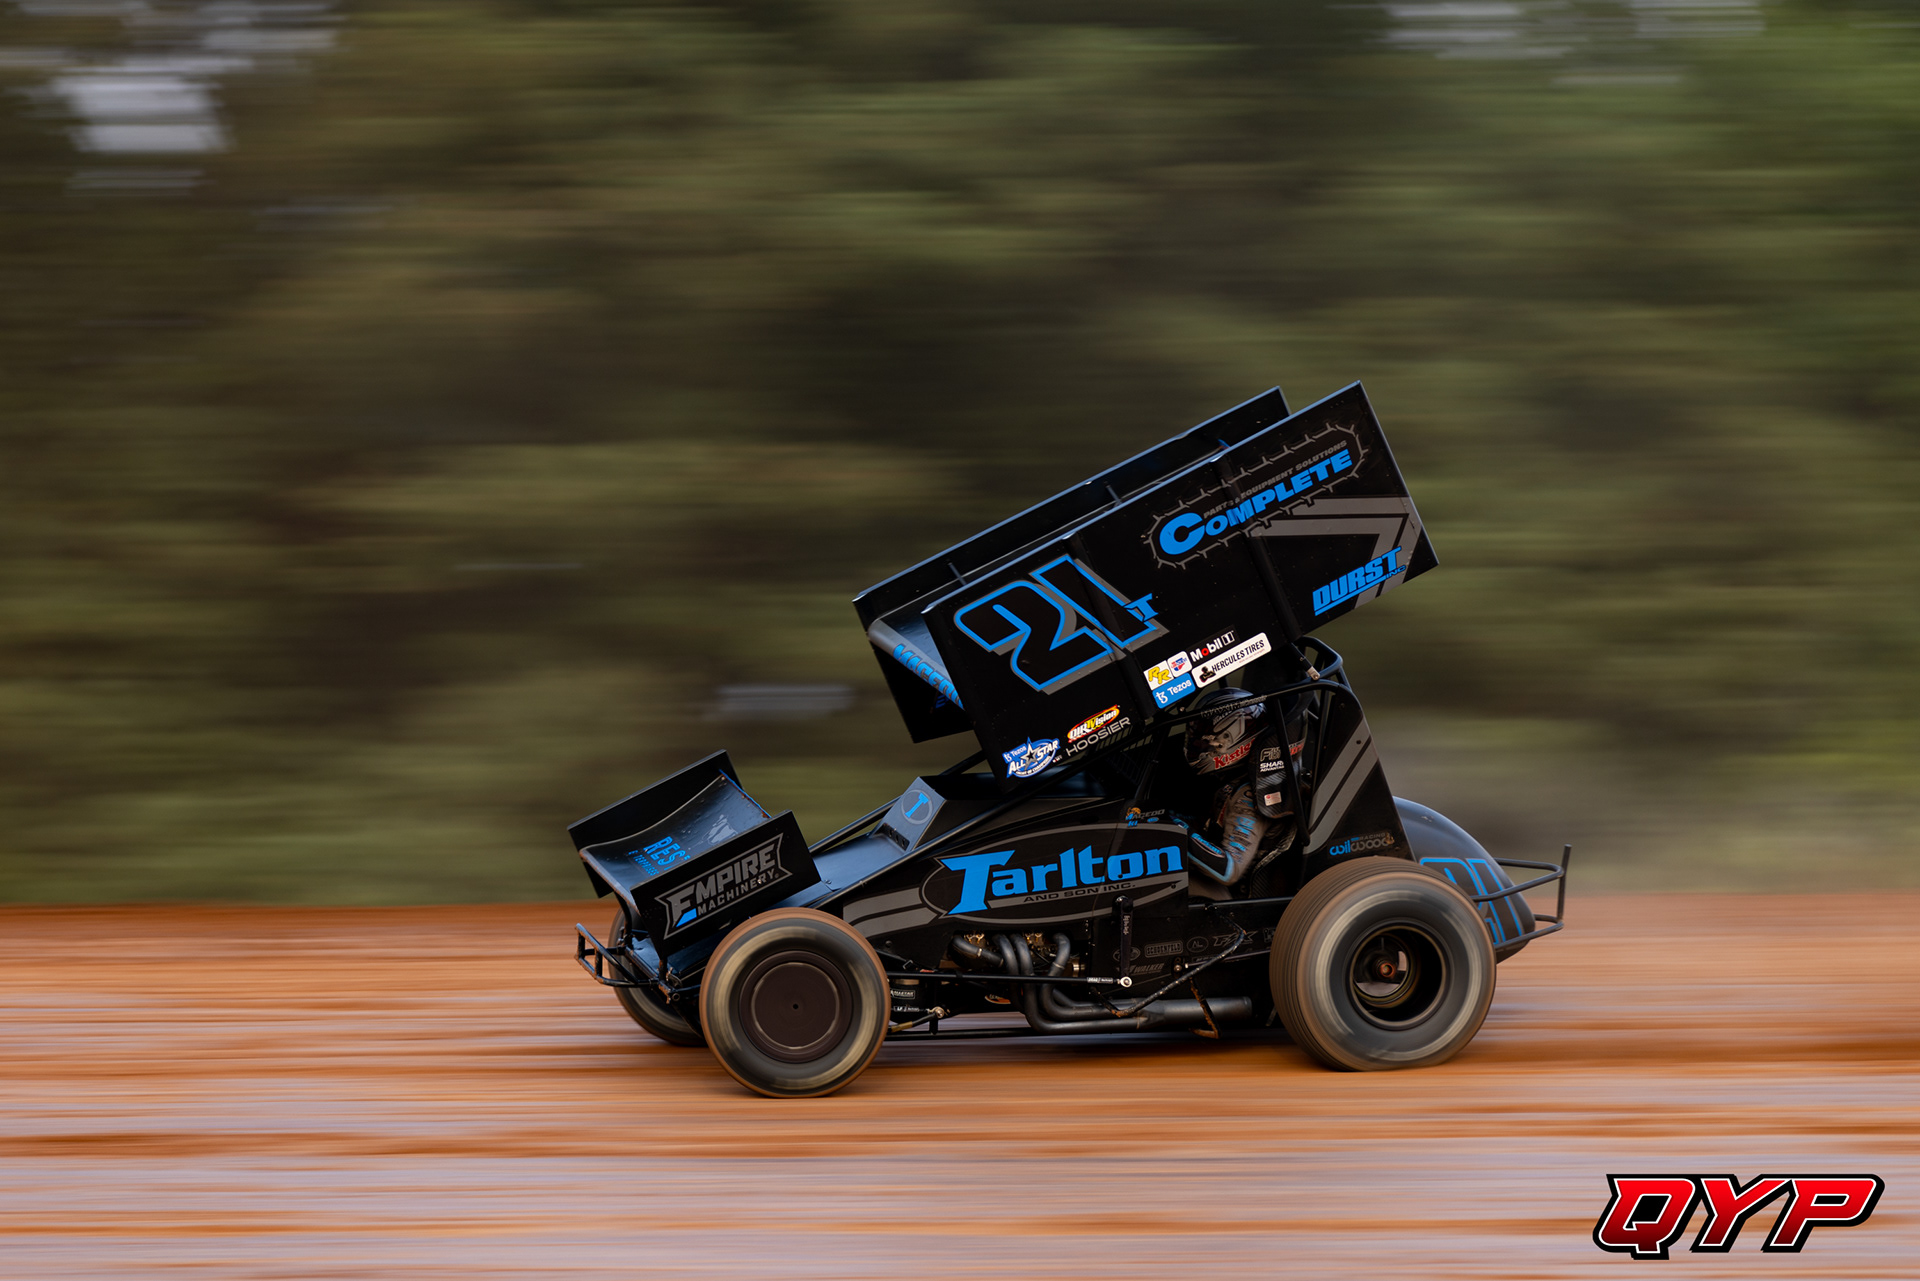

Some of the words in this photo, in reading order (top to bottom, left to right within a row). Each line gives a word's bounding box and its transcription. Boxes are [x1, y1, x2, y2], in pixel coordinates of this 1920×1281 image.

[1203, 501, 1234, 519] PARTS
[1240, 467, 1295, 499] EQUIPMENT
[1295, 440, 1348, 471] SOLUTIONS
[1159, 449, 1353, 555] COMPLETE
[1312, 545, 1402, 612] DURST
[1385, 564, 1407, 579] INC
[1190, 637, 1223, 663] Mobil
[1211, 649, 1246, 673] HERCULES
[1244, 639, 1265, 656] TIRES
[1148, 666, 1172, 685] RR
[1167, 679, 1192, 696] Tezos
[1010, 745, 1027, 757] Tezos
[1065, 716, 1131, 757] HOOSIER
[1008, 759, 1027, 775] ALL
[1037, 739, 1059, 761] STAR
[666, 843, 776, 928] EMPIRE
[697, 868, 775, 917] MACHINERY
[940, 844, 1184, 915] Tarlton
[1023, 892, 1060, 904] AND
[1062, 887, 1098, 899] SON
[1100, 882, 1136, 895] INC.
